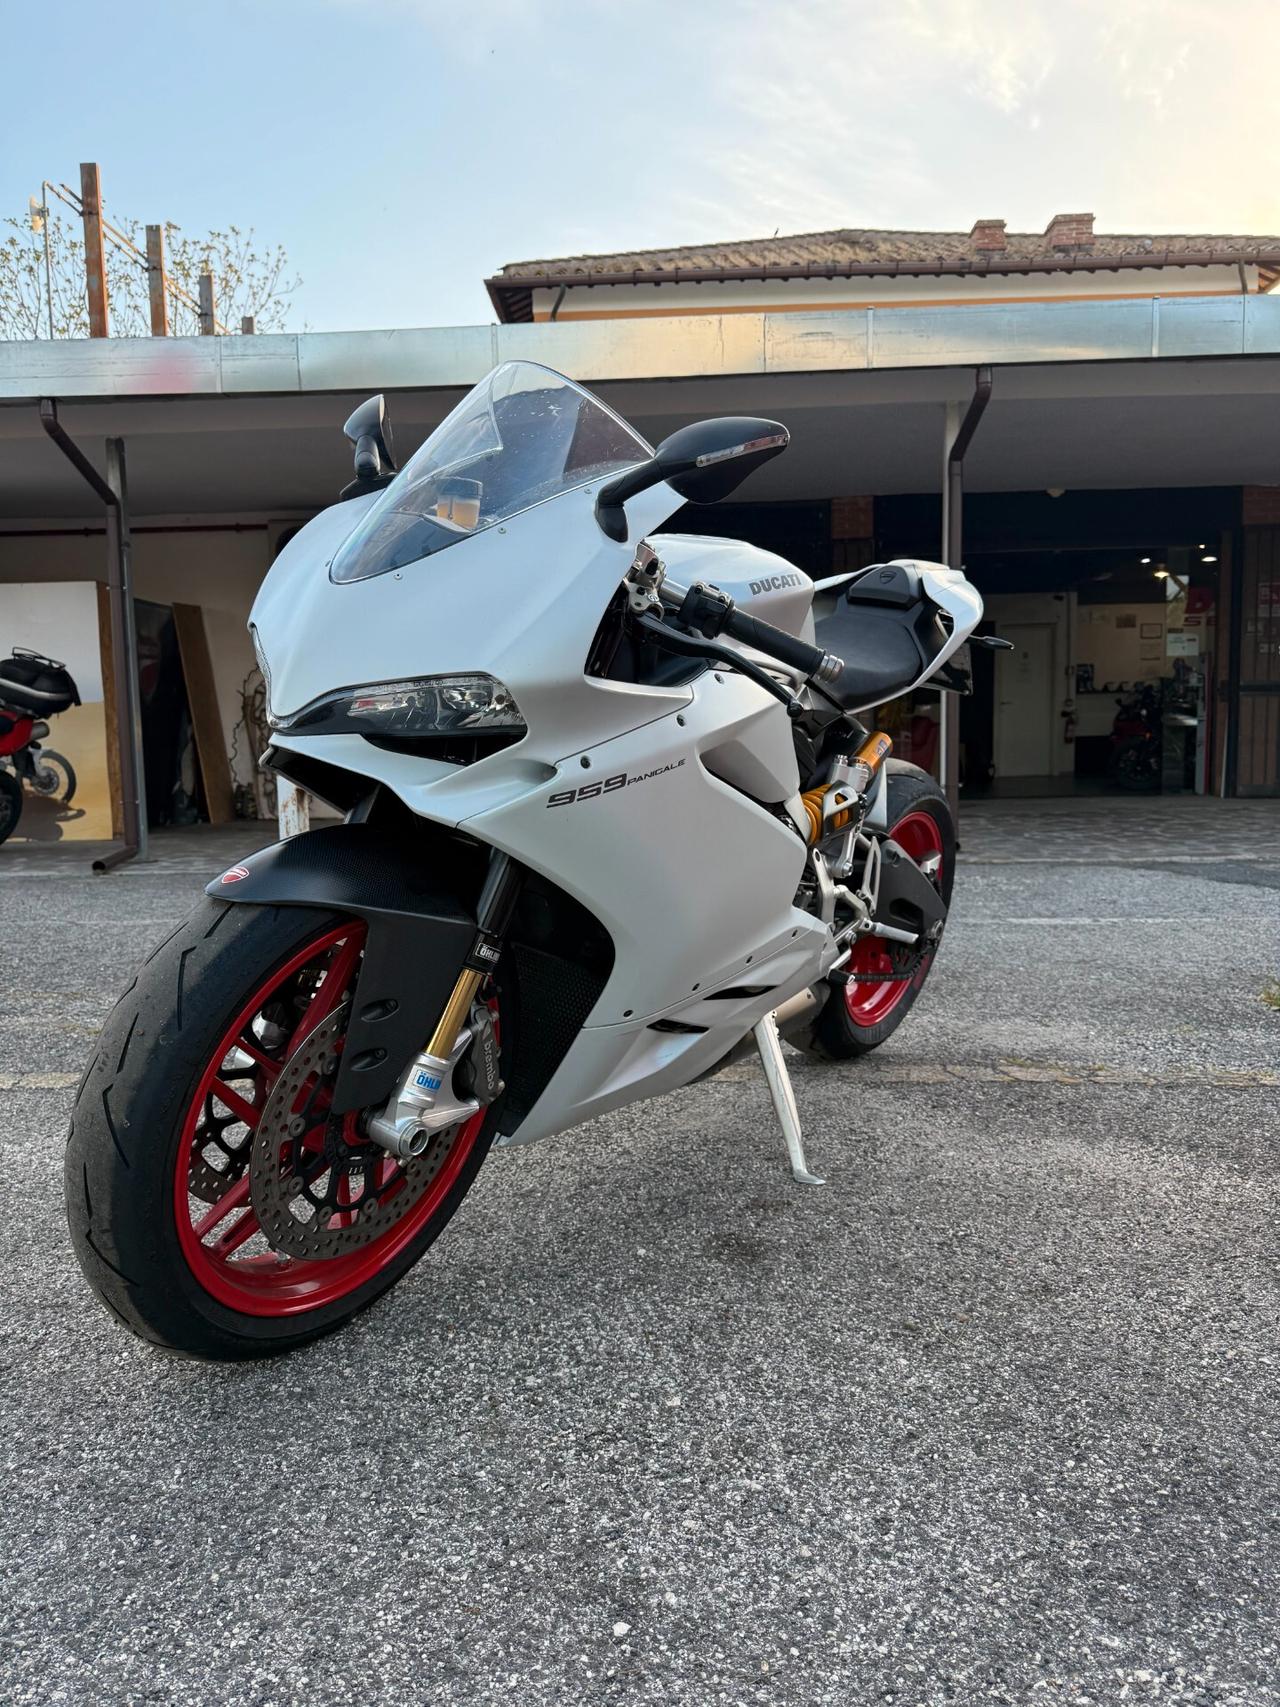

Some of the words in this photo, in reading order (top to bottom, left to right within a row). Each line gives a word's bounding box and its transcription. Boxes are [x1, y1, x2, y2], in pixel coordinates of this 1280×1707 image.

[748, 574, 802, 596] DUCATI
[546, 773, 628, 808] 959
[627, 758, 687, 786] PANIGALE
[483, 1039, 497, 1091] brembo
